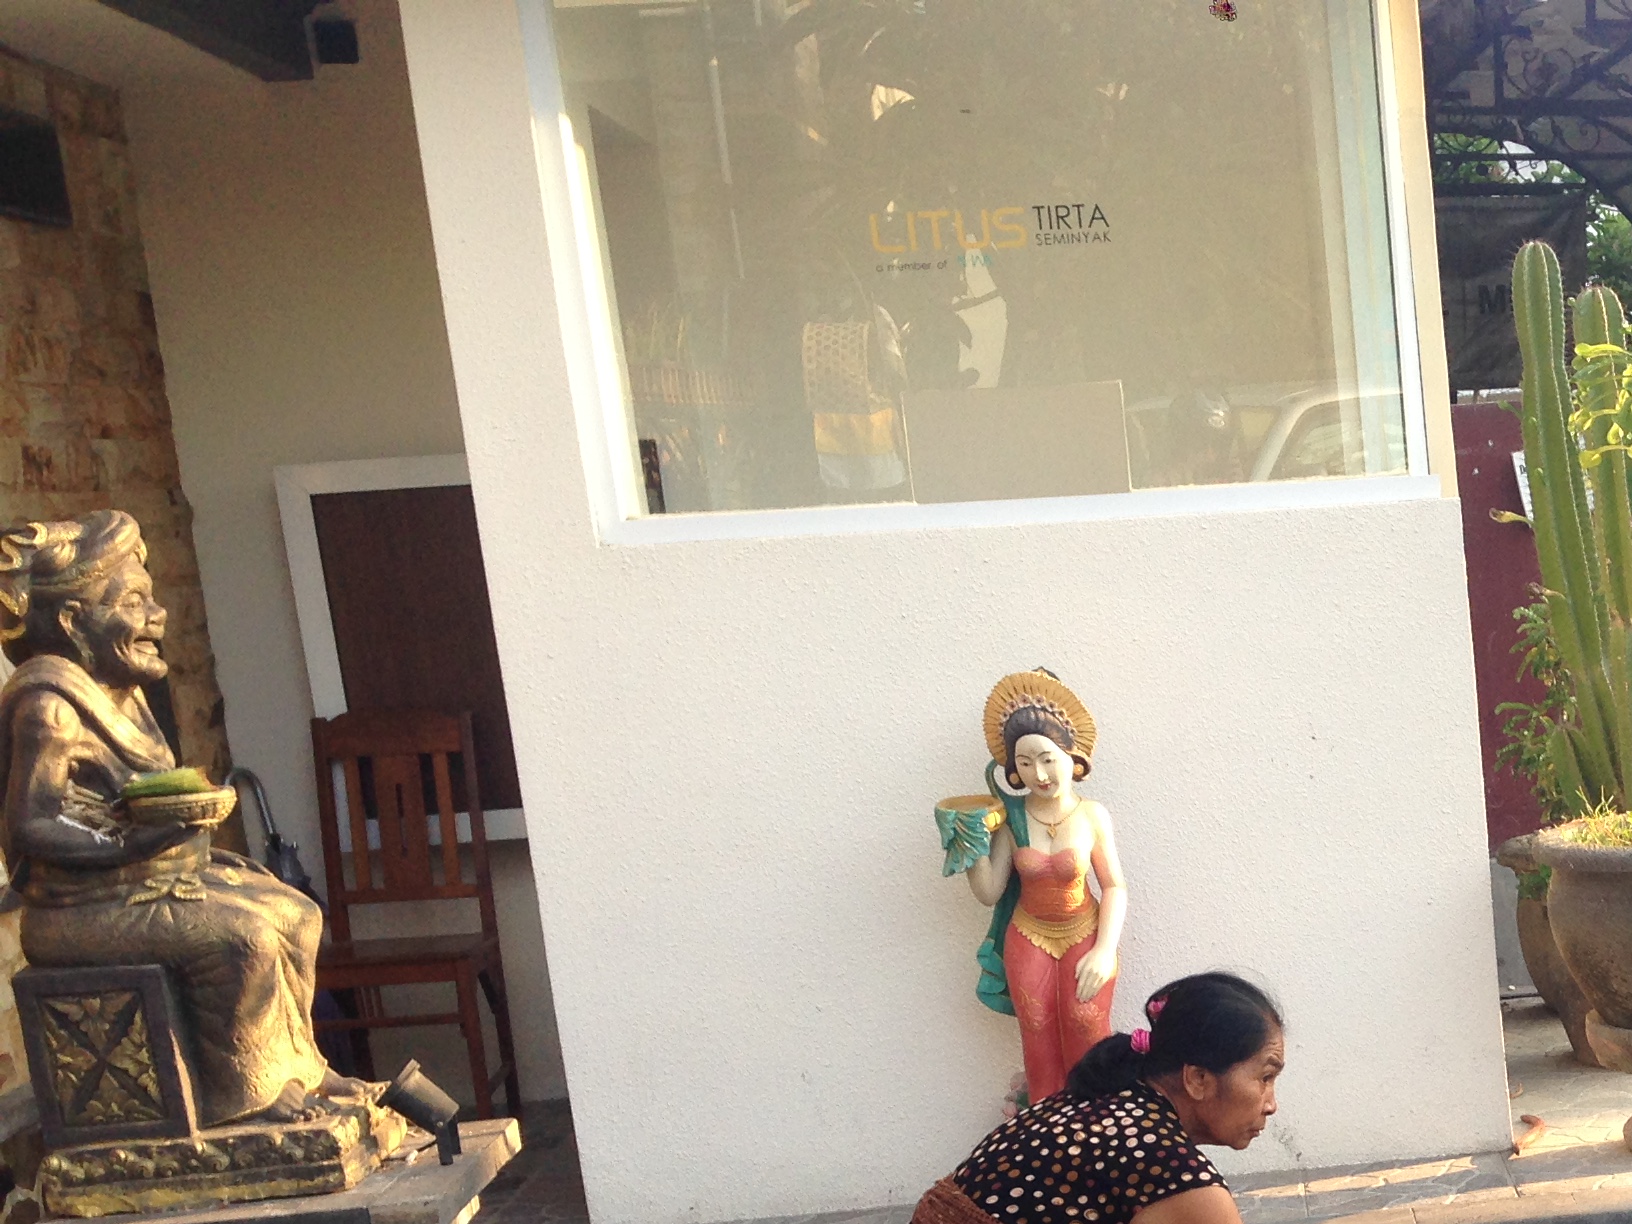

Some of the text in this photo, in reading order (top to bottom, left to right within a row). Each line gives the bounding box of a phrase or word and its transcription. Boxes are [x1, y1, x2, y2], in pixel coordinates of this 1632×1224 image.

[869, 204, 1110, 253] LITUS TIRTA
[1035, 230, 1112, 246] SEMINYAK
[887, 261, 931, 271] member
[937, 260, 948, 270] of
